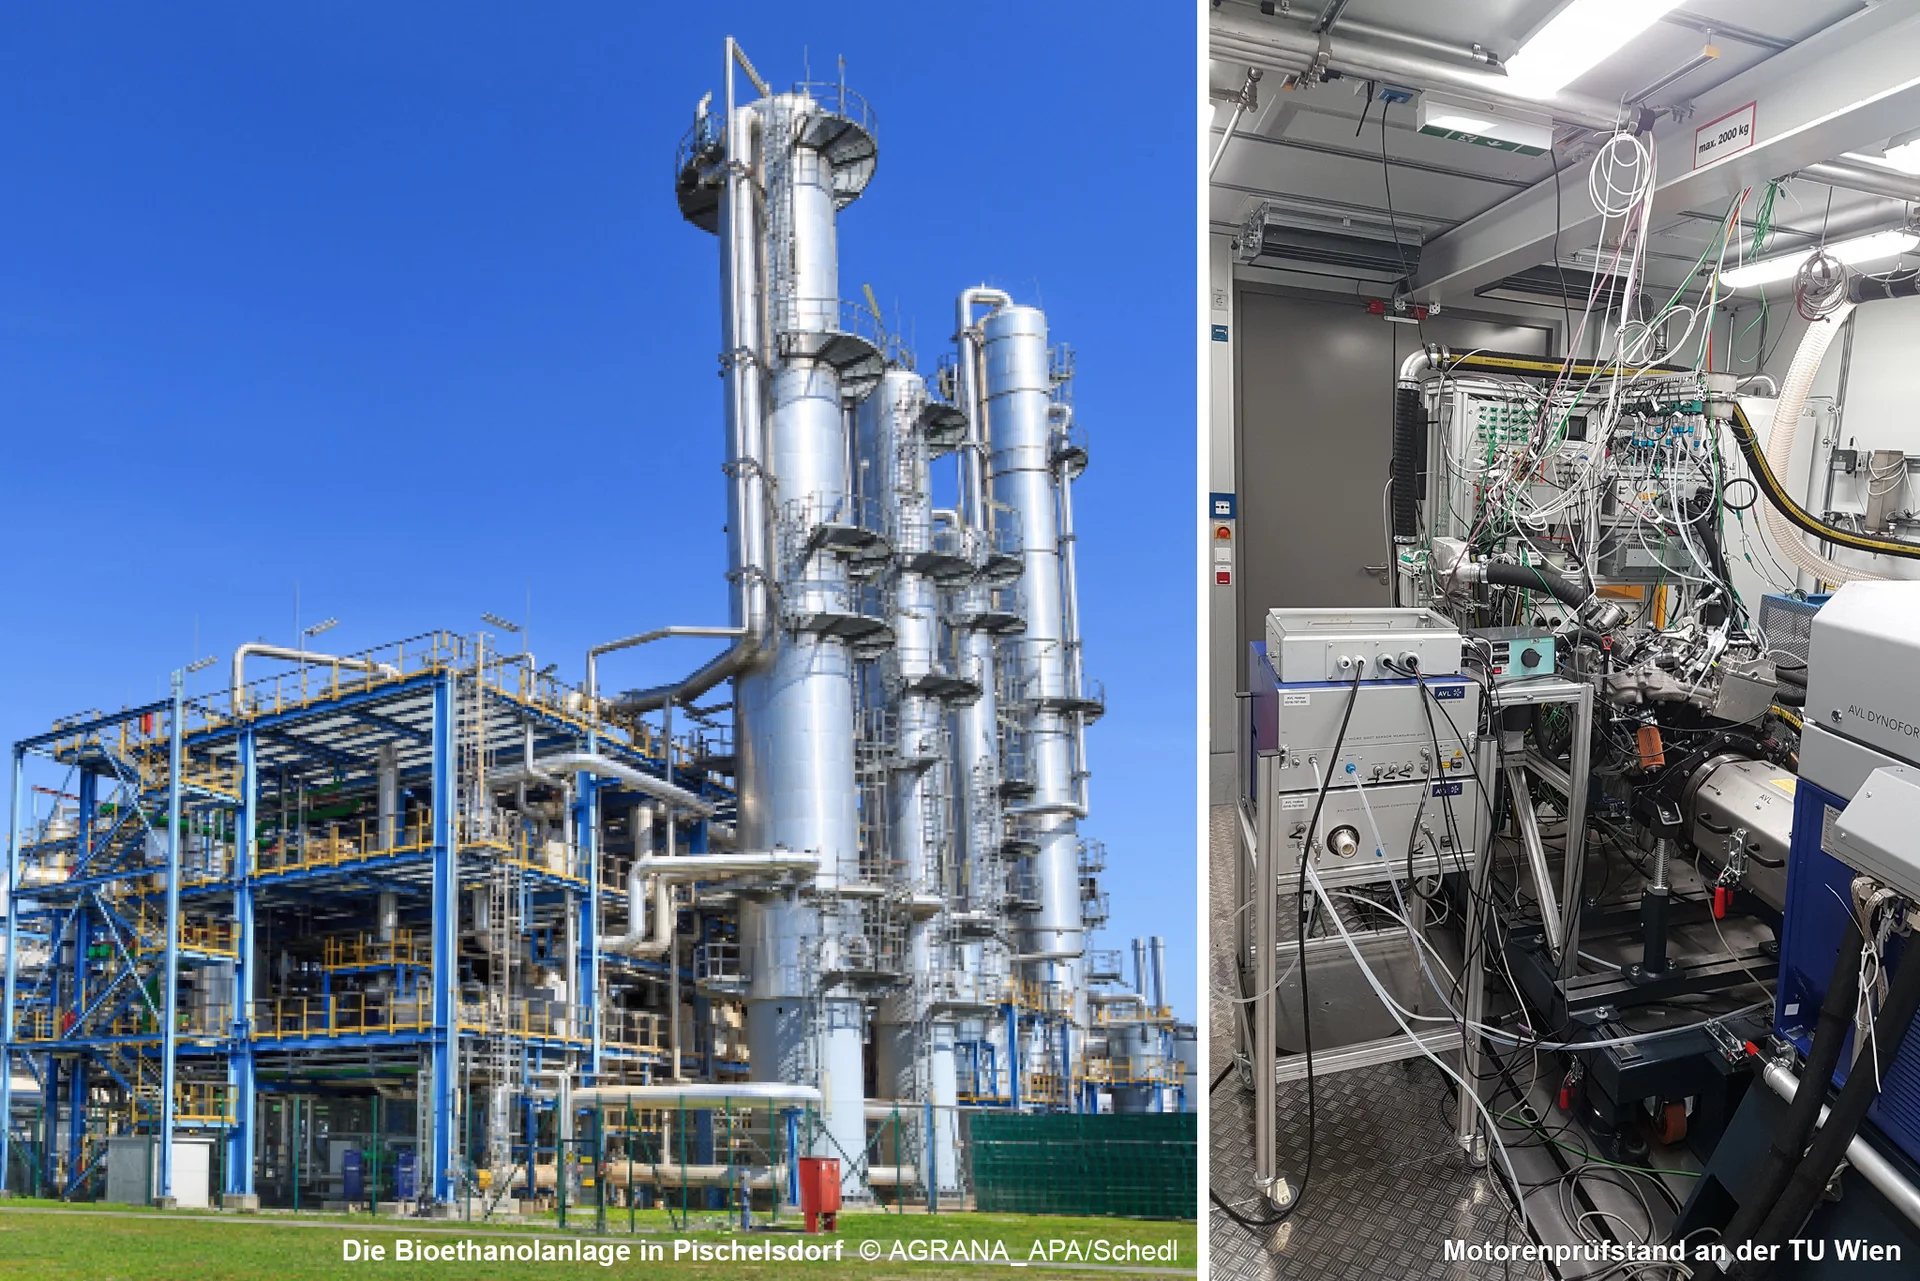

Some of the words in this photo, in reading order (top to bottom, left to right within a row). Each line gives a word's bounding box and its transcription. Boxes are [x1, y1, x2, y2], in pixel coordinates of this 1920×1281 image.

[1699, 139, 1716, 154] max.
[1718, 127, 1737, 145] 2000
[1739, 124, 1749, 136] kg
[1847, 704, 1866, 720] AVL
[1867, 710, 1920, 739] DYNOFOR
[1759, 793, 1772, 805] AVL
